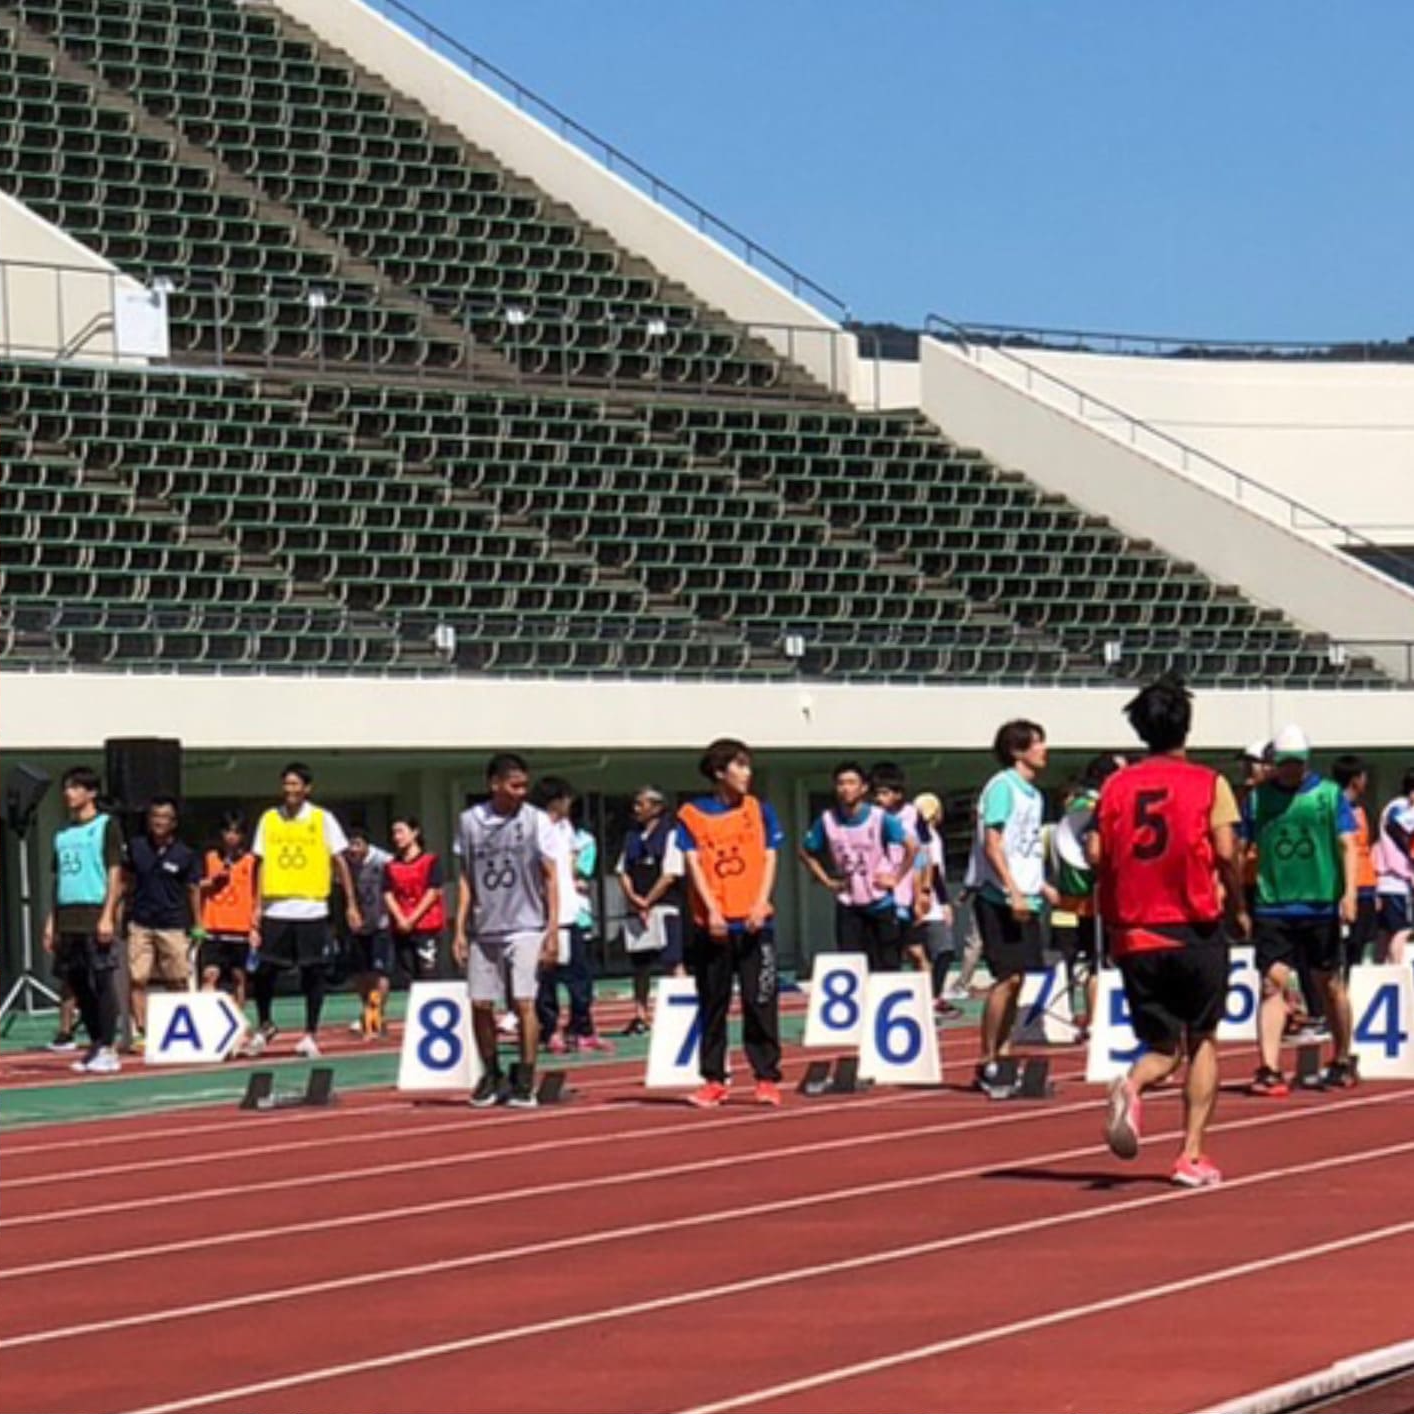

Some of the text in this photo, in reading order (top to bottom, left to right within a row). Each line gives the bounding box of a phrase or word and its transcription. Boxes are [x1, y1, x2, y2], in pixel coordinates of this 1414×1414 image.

[1133, 789, 1171, 860] 5
[160, 1004, 204, 1052] A
[666, 996, 703, 1068] 7
[821, 969, 859, 1031] 8
[874, 989, 922, 1066] 6
[1024, 965, 1058, 1028] 7
[1353, 983, 1408, 1058] 4
[417, 1000, 462, 1071] 8
